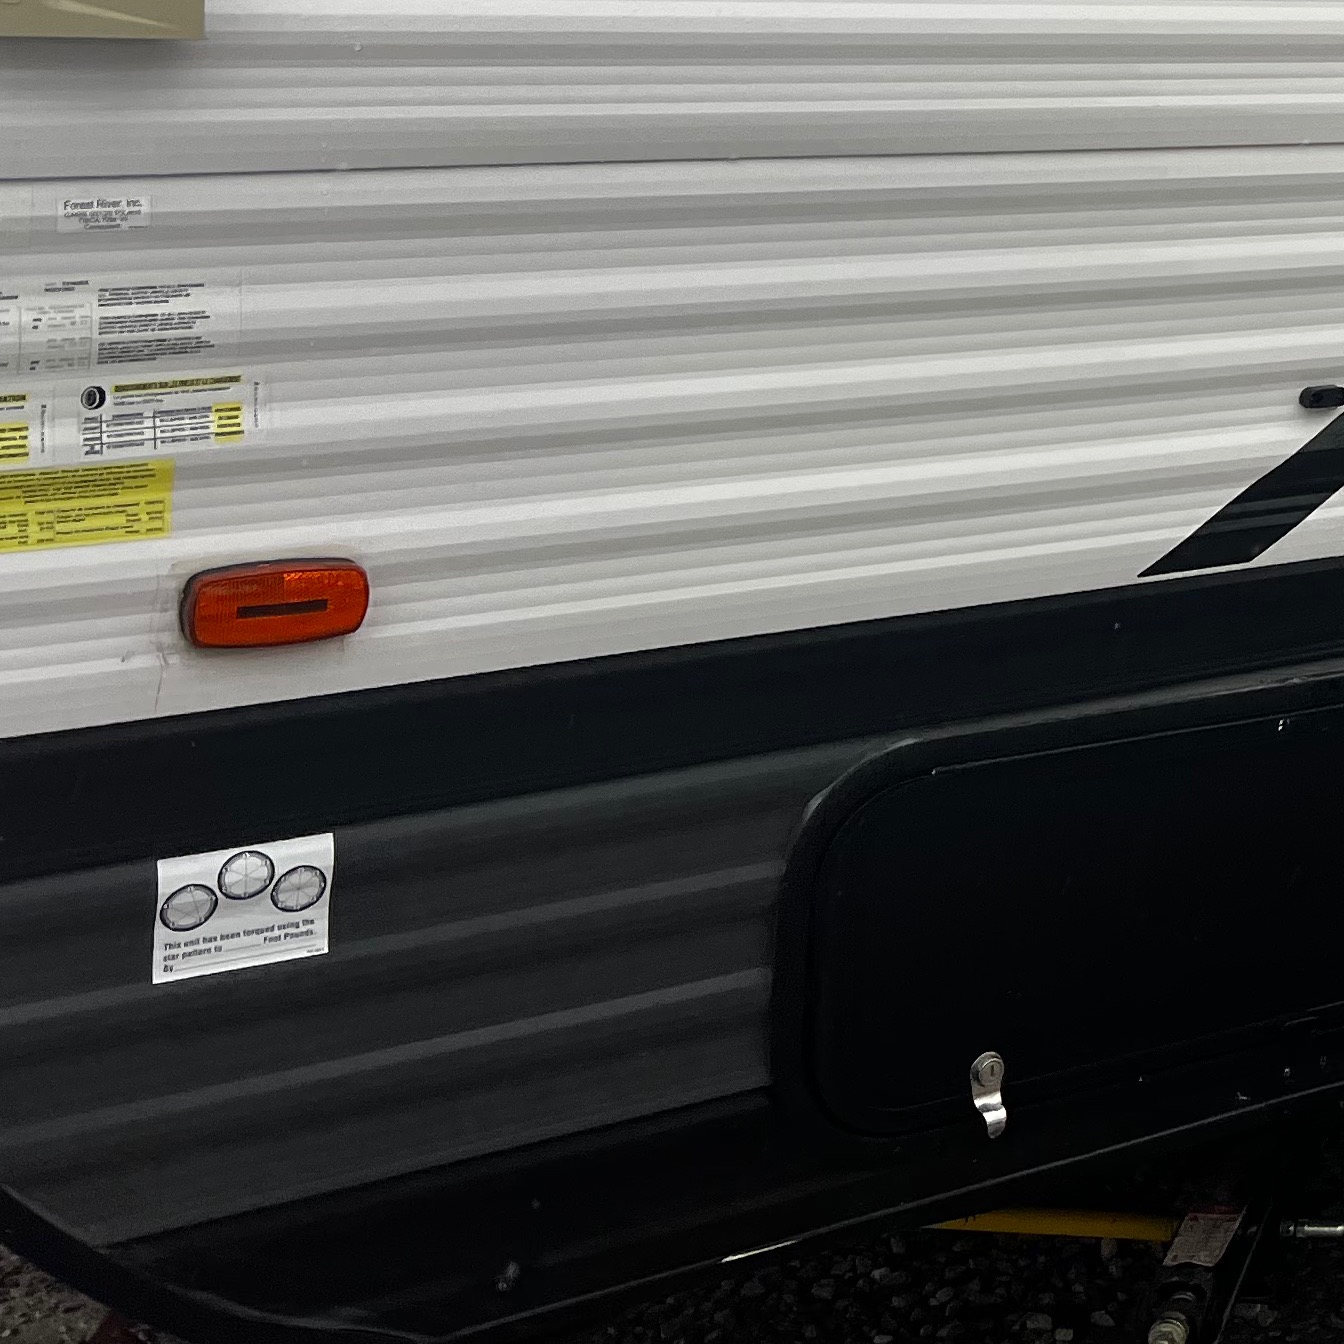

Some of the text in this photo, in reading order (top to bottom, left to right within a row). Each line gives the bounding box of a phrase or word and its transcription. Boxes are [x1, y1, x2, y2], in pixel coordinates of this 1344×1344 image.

[164, 941, 182, 951] This
[183, 937, 200, 948] unit
[202, 935, 218, 945] has
[220, 932, 241, 942] been
